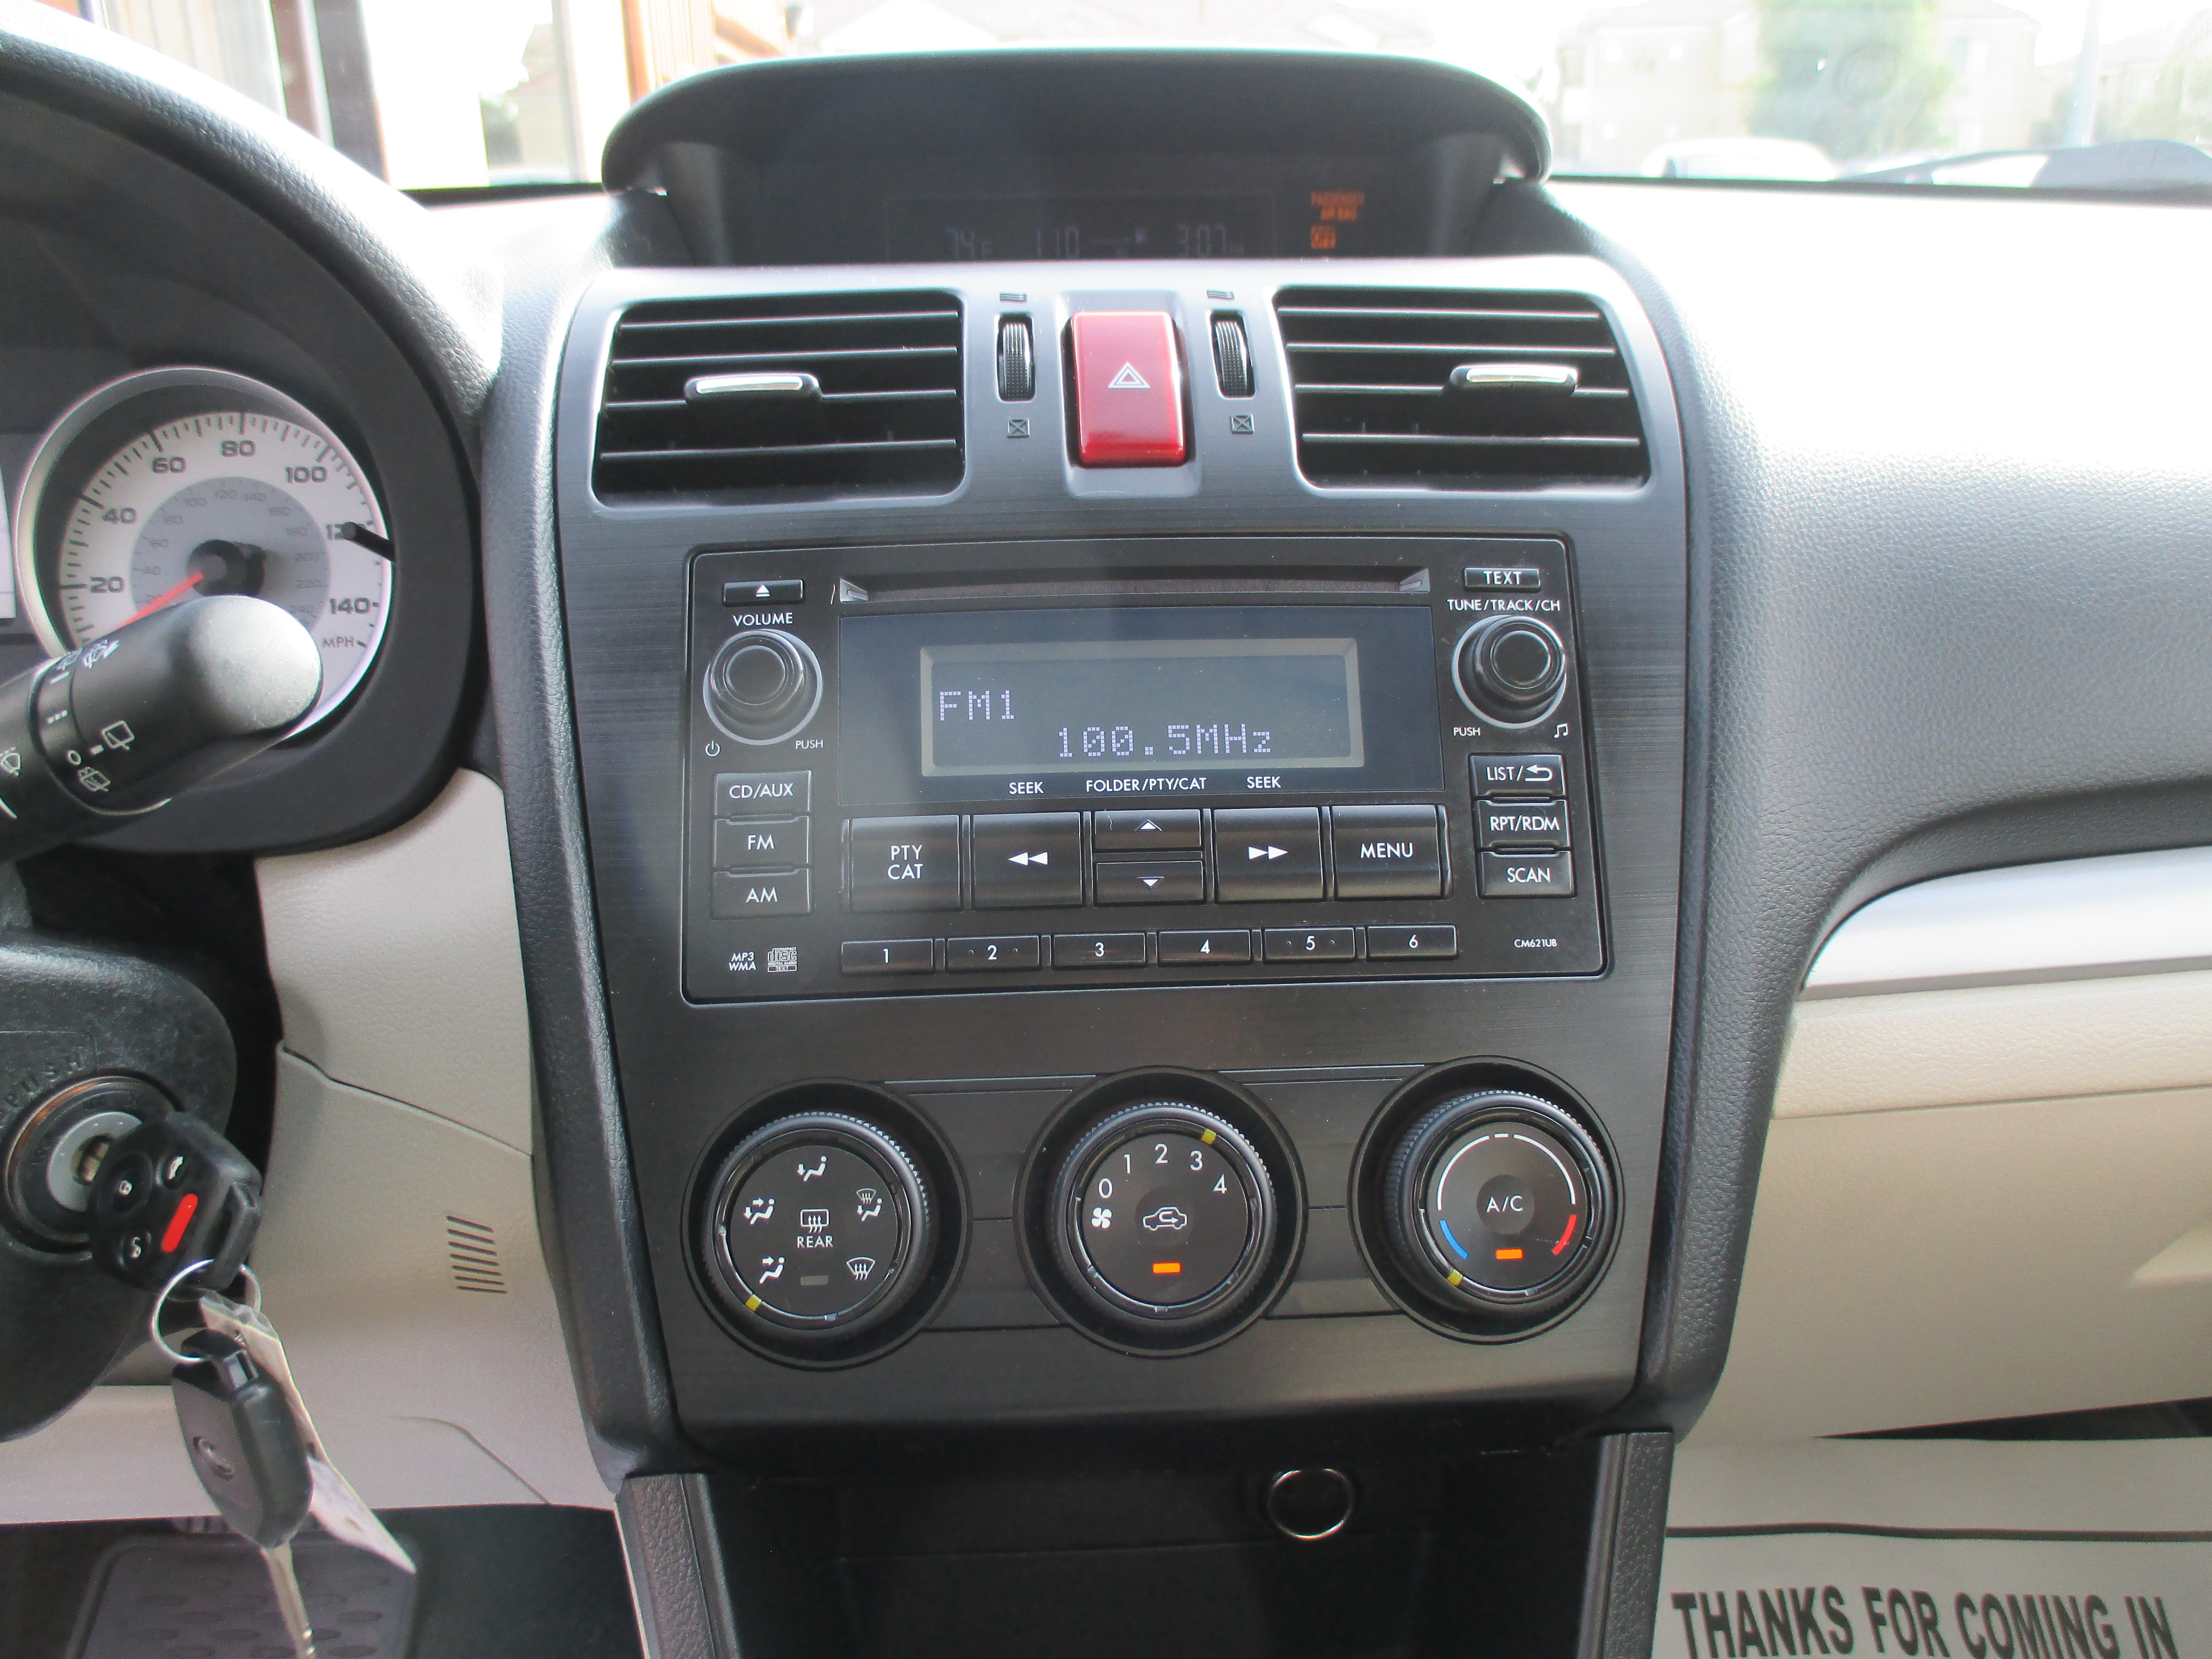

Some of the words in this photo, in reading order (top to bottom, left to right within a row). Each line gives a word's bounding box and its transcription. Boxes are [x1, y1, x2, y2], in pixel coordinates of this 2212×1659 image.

[221, 440, 256, 457] 80
[152, 457, 187, 474] 60
[285, 466, 329, 484] 100
[102, 507, 137, 525] 40
[90, 577, 125, 593] 20
[1483, 571, 1522, 585] TEXT
[330, 598, 372, 614] 140
[1447, 599, 1561, 612] TUNE/TRACK/CH
[733, 612, 793, 626] VOLUME
[324, 636, 355, 648] MPH
[939, 689, 1016, 721] FM1
[1058, 722, 1272, 758] 100.5MHz
[1453, 727, 1481, 737] PUSH
[795, 739, 824, 749] PUSH
[1009, 781, 1044, 795] SEEK
[1086, 776, 1207, 793] FOLDER/PTY/CAT
[1247, 775, 1282, 789] SEEK
[729, 782, 794, 799] CD/AUX
[1490, 814, 1560, 832] RPT/RDM
[747, 834, 775, 850] FM
[890, 844, 923, 861] PTY
[1360, 842, 1414, 859] MENU
[887, 863, 923, 880] CAT
[1506, 867, 1551, 883] SCAN
[745, 887, 779, 903] AM
[1200, 939, 1211, 954] 4
[1306, 935, 1316, 951] 5
[1408, 933, 1419, 949] 6
[1514, 938, 1558, 948] CM621UB
[731, 951, 755, 962] MP3
[882, 948, 890, 963] 1
[987, 944, 998, 960] 2
[1094, 942, 1105, 957] 3
[729, 961, 757, 971] WMA
[1154, 1143, 1168, 1164] 2
[1189, 1150, 1203, 1171] 3
[1123, 1154, 1131, 1174] 1
[1098, 1178, 1113, 1199] 0
[1213, 1174, 1227, 1194] 4
[1486, 1194, 1524, 1214] A/C
[796, 1235, 834, 1249] REAR
[1671, 1585, 1854, 1659] THANKS
[1861, 1586, 1951, 1658] FOR
[1954, 1592, 2121, 1659] COMING
[2124, 1595, 2181, 1659] IN
